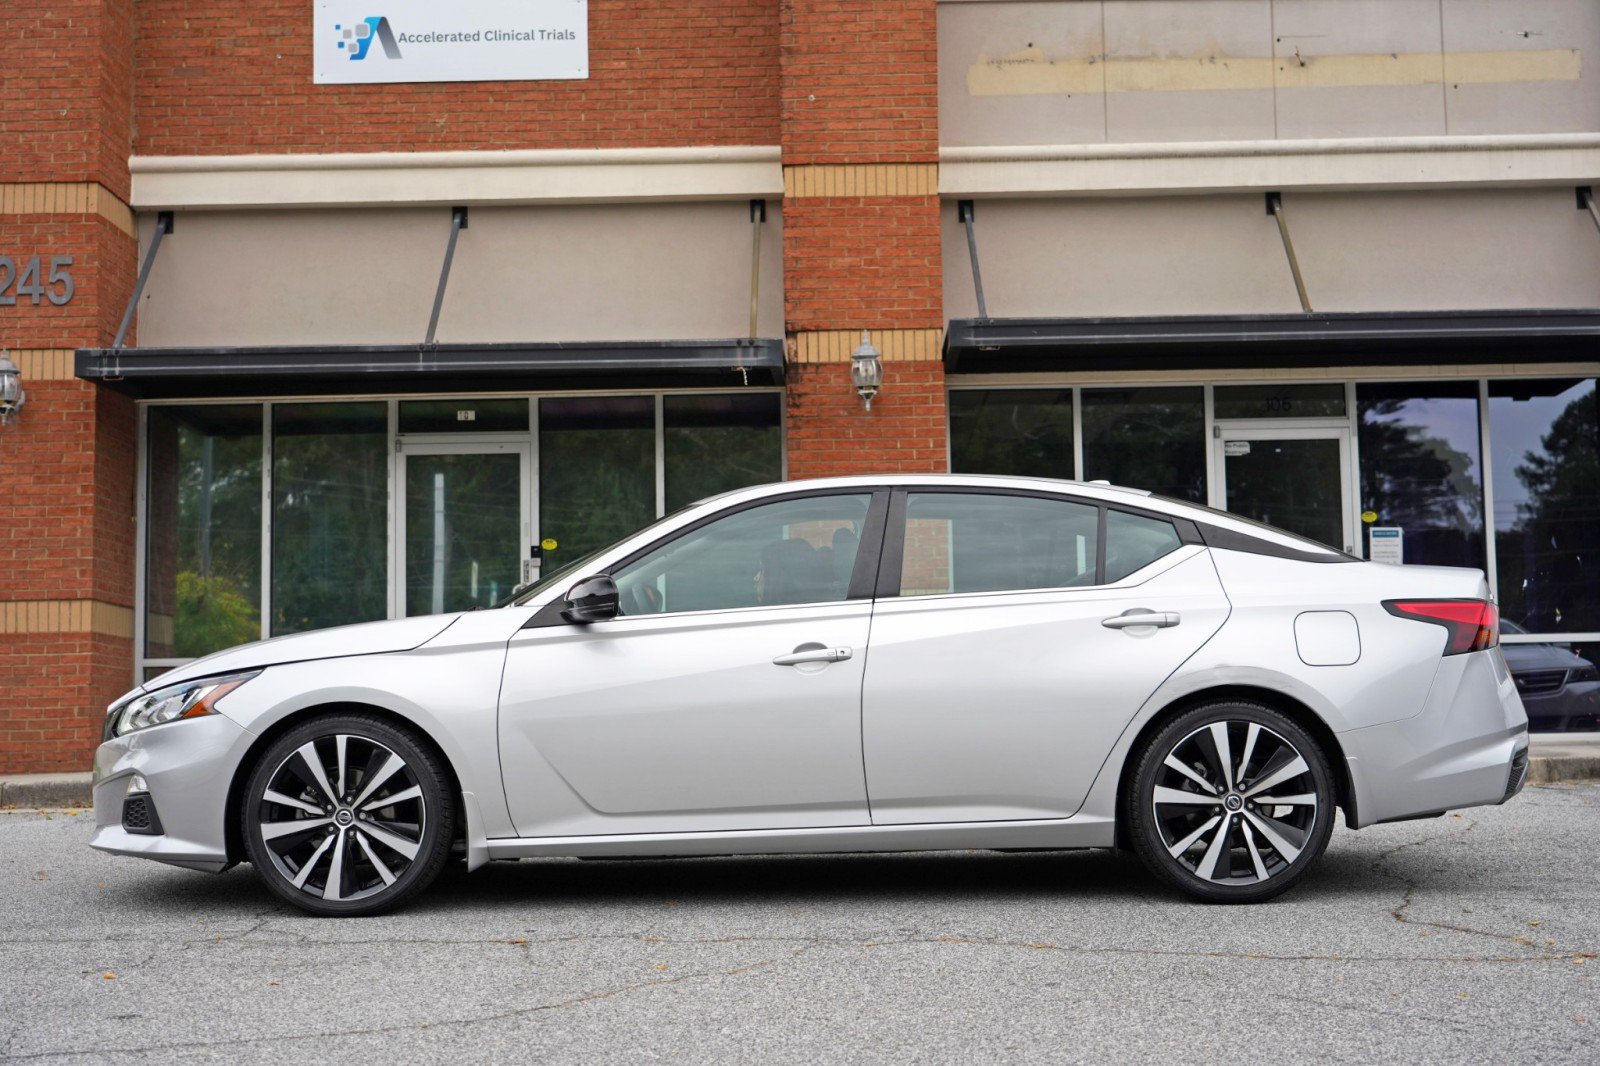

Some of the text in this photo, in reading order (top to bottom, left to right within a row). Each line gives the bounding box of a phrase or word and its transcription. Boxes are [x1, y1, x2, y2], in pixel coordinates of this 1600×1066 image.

[398, 29, 576, 43] Accelerated Clinical Trials
[0, 256, 74, 306] 245
